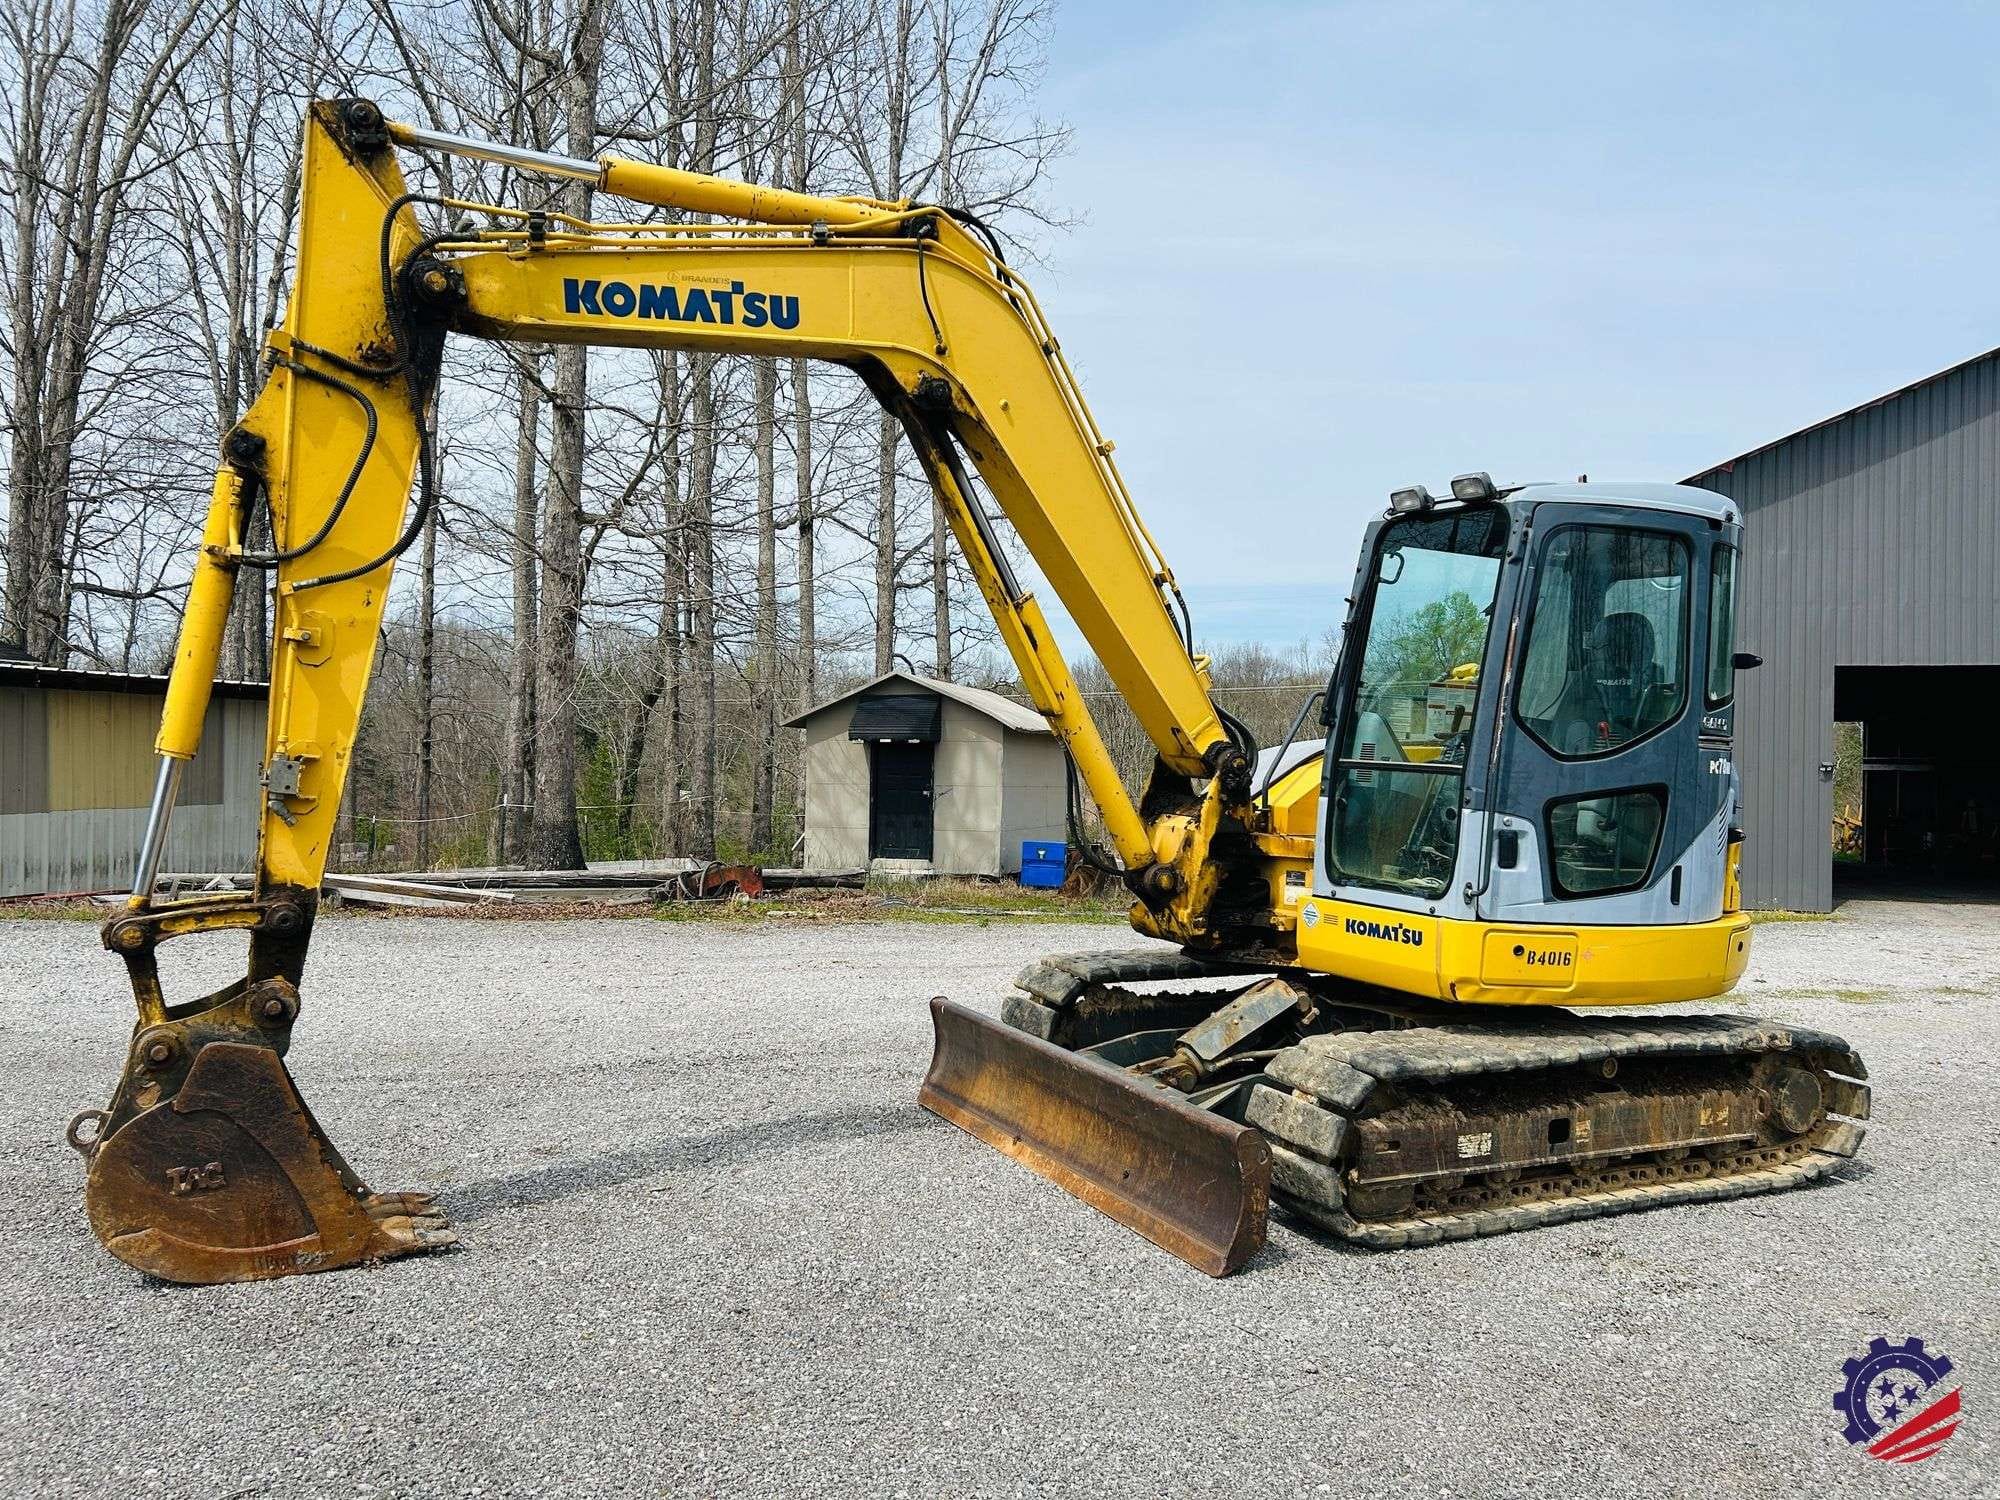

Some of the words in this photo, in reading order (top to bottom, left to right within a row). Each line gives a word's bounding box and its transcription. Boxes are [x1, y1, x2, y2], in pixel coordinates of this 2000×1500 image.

[563, 277, 800, 330] KOMATSU
[1345, 917, 1423, 947] KOMATSU
[1527, 950, 1572, 967] B4016
